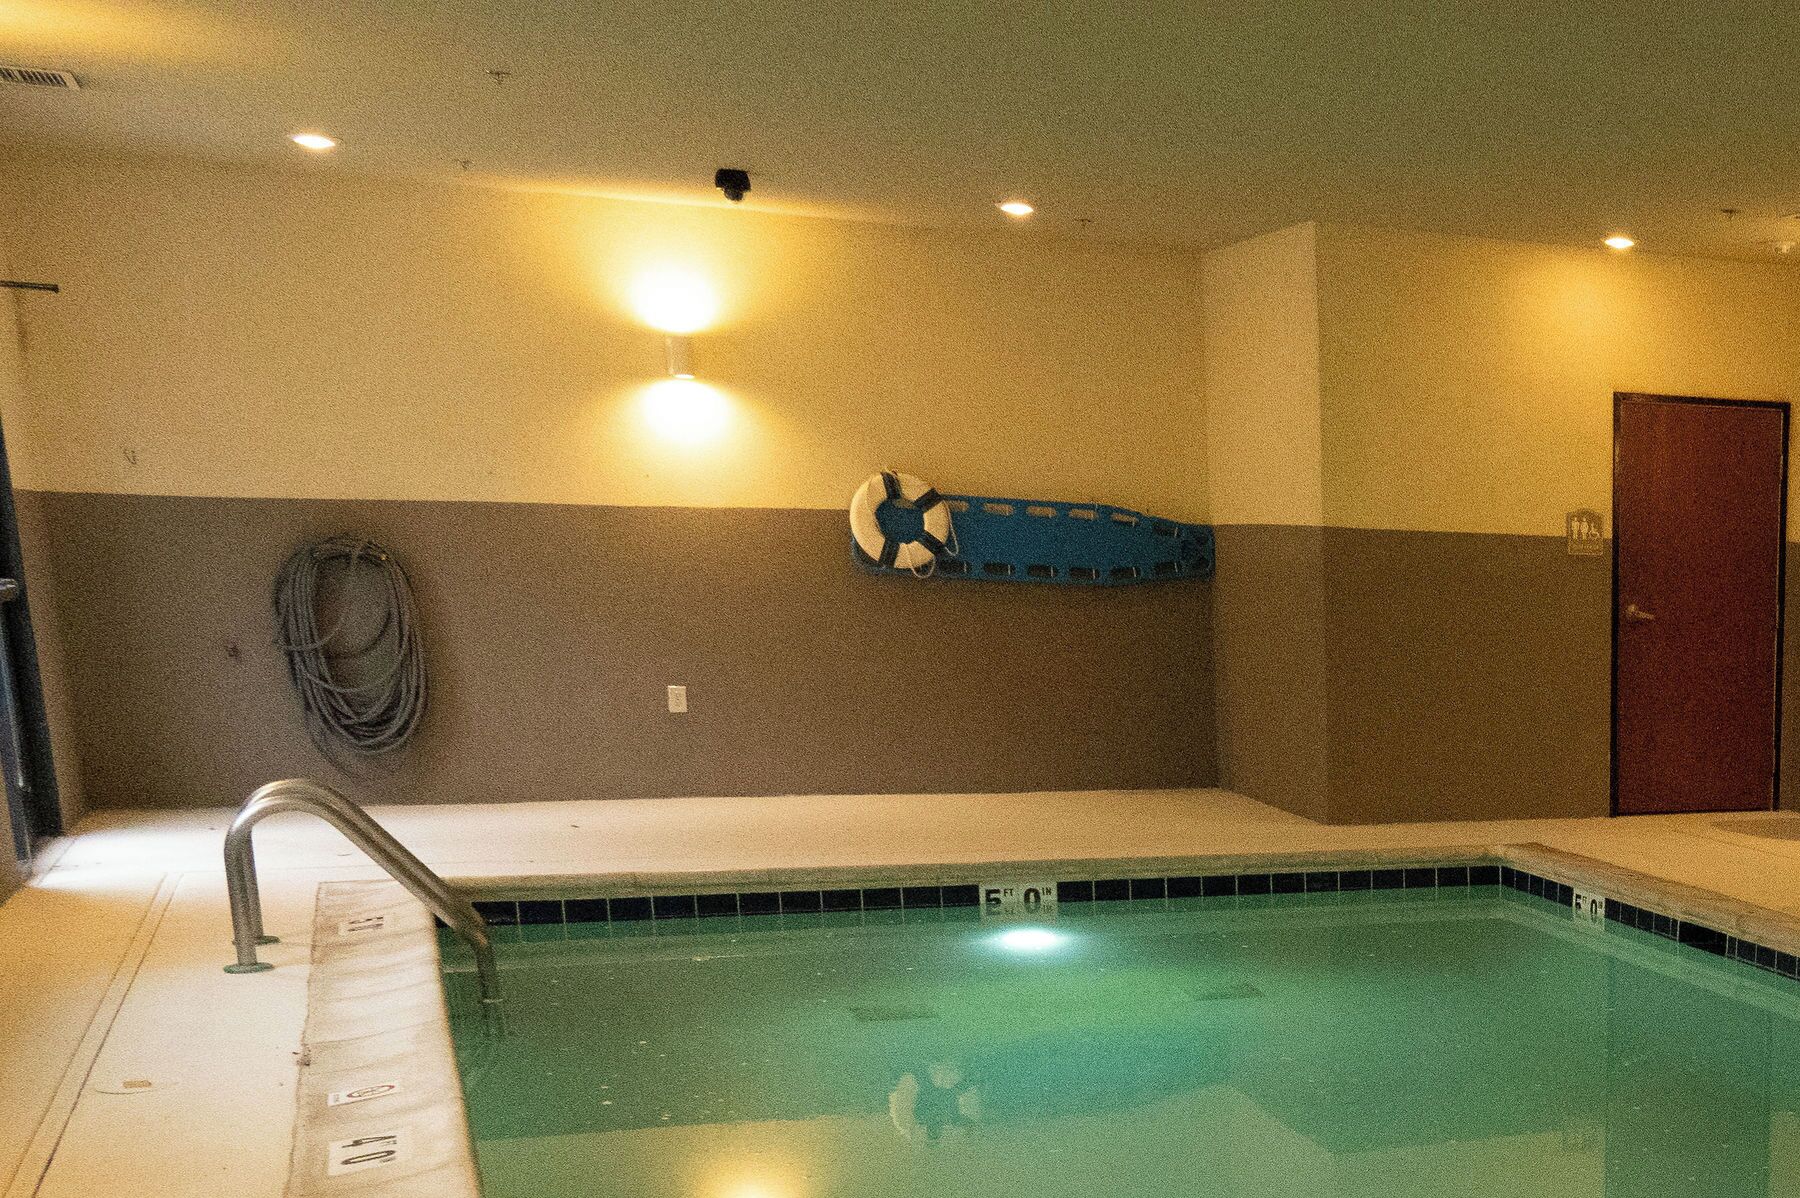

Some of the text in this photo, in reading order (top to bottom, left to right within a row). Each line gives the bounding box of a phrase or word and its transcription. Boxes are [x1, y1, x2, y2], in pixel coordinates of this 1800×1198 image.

[985, 888, 1002, 904] 5
[1003, 888, 1014, 897] FT
[1023, 887, 1041, 904] 0
